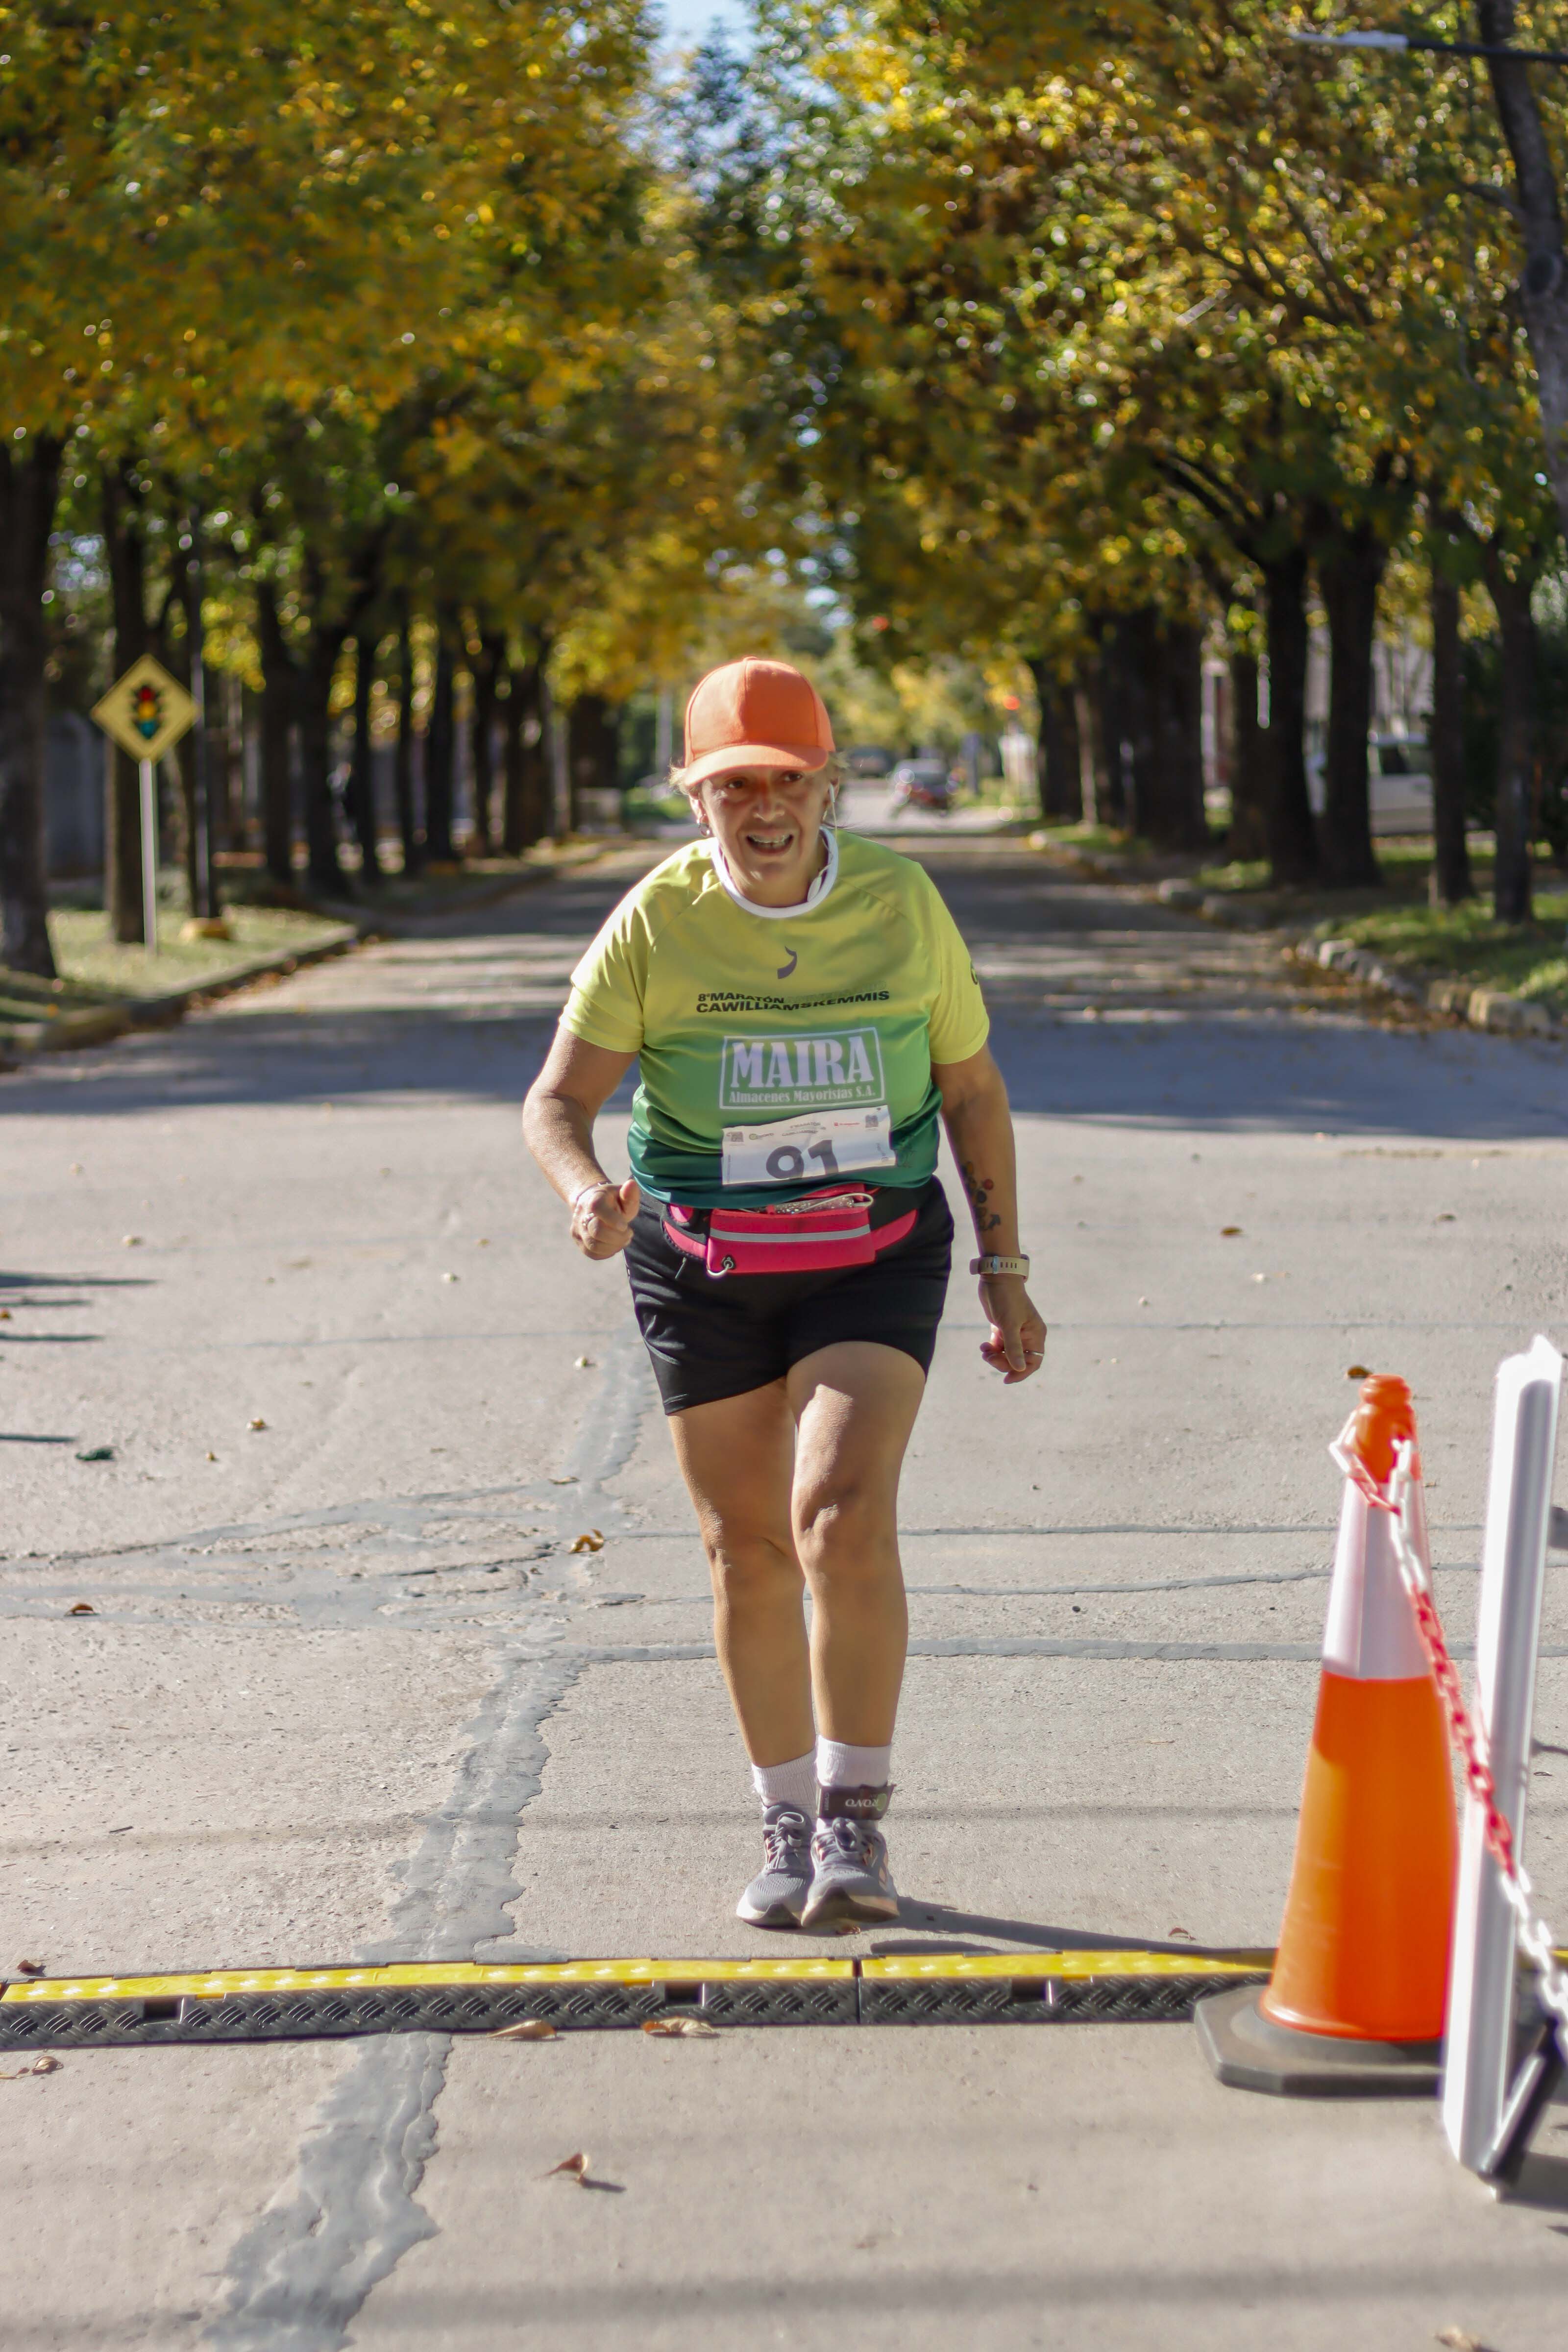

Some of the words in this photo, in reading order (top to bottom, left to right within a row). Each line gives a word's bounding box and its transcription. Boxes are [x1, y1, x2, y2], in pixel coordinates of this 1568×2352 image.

[730, 1036, 874, 1087] MAIRA
[729, 1091, 790, 1103] Almacenes
[793, 1088, 852, 1102] Mayoristas
[856, 1084, 876, 1097] S.A.
